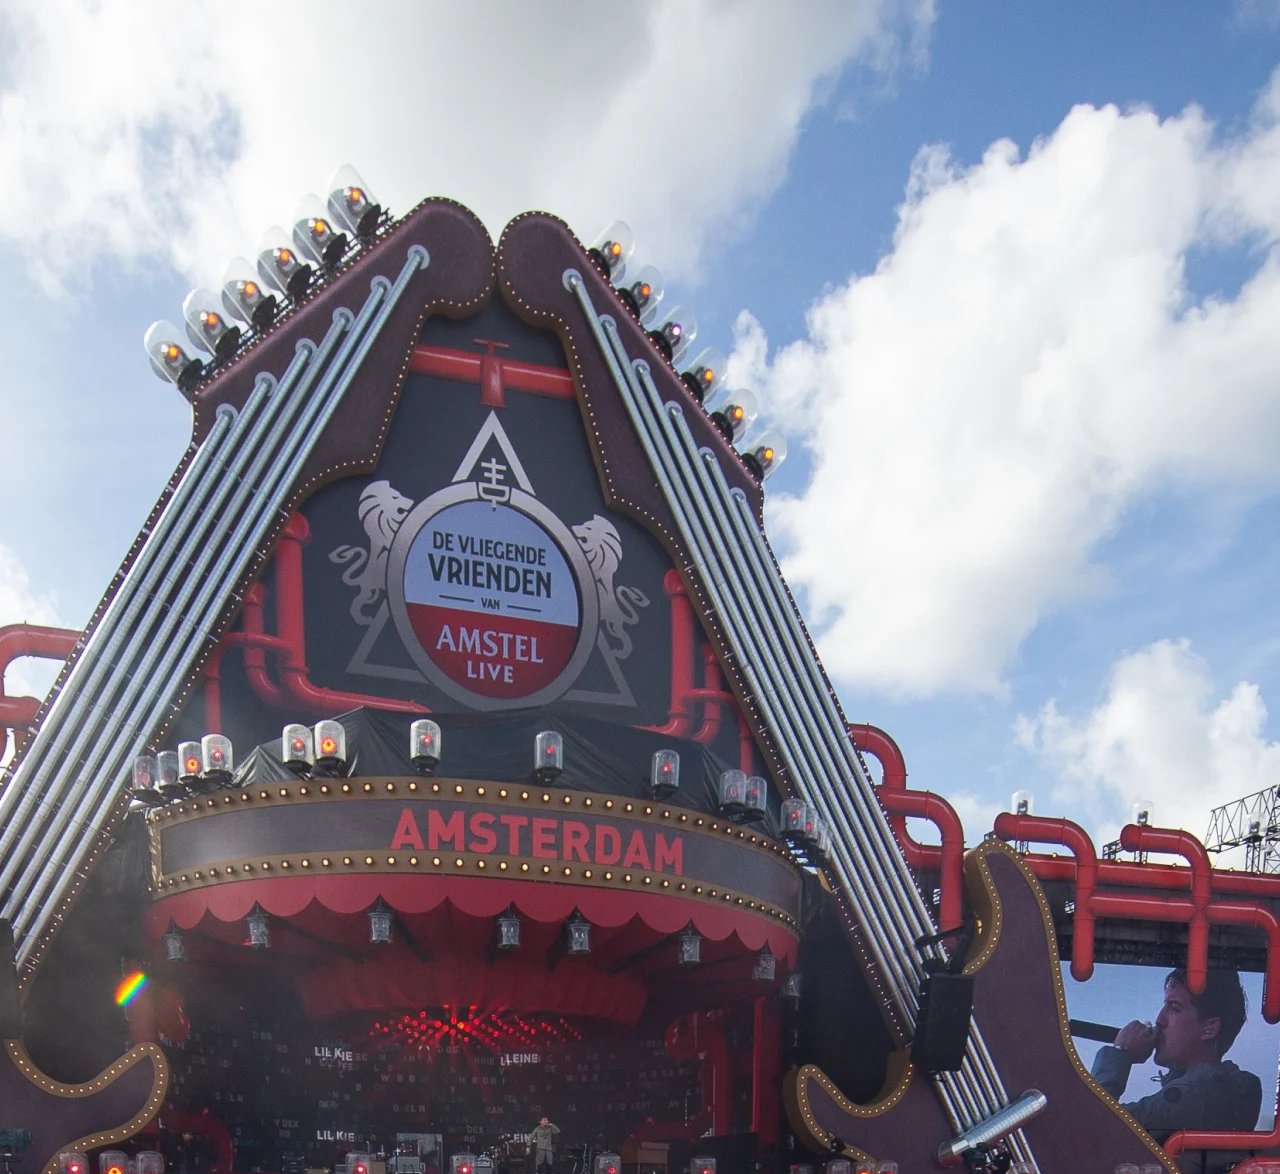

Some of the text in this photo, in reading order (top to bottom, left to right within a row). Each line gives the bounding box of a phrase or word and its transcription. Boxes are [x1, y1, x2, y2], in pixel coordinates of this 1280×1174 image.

[433, 531, 547, 567] DE VLIEGENDE
[427, 553, 552, 599] VRIENDEN
[481, 598, 500, 611] VAN
[436, 624, 544, 664] AMSTEL
[467, 660, 514, 684] LIVE
[389, 808, 683, 877] AMSTERDAM
